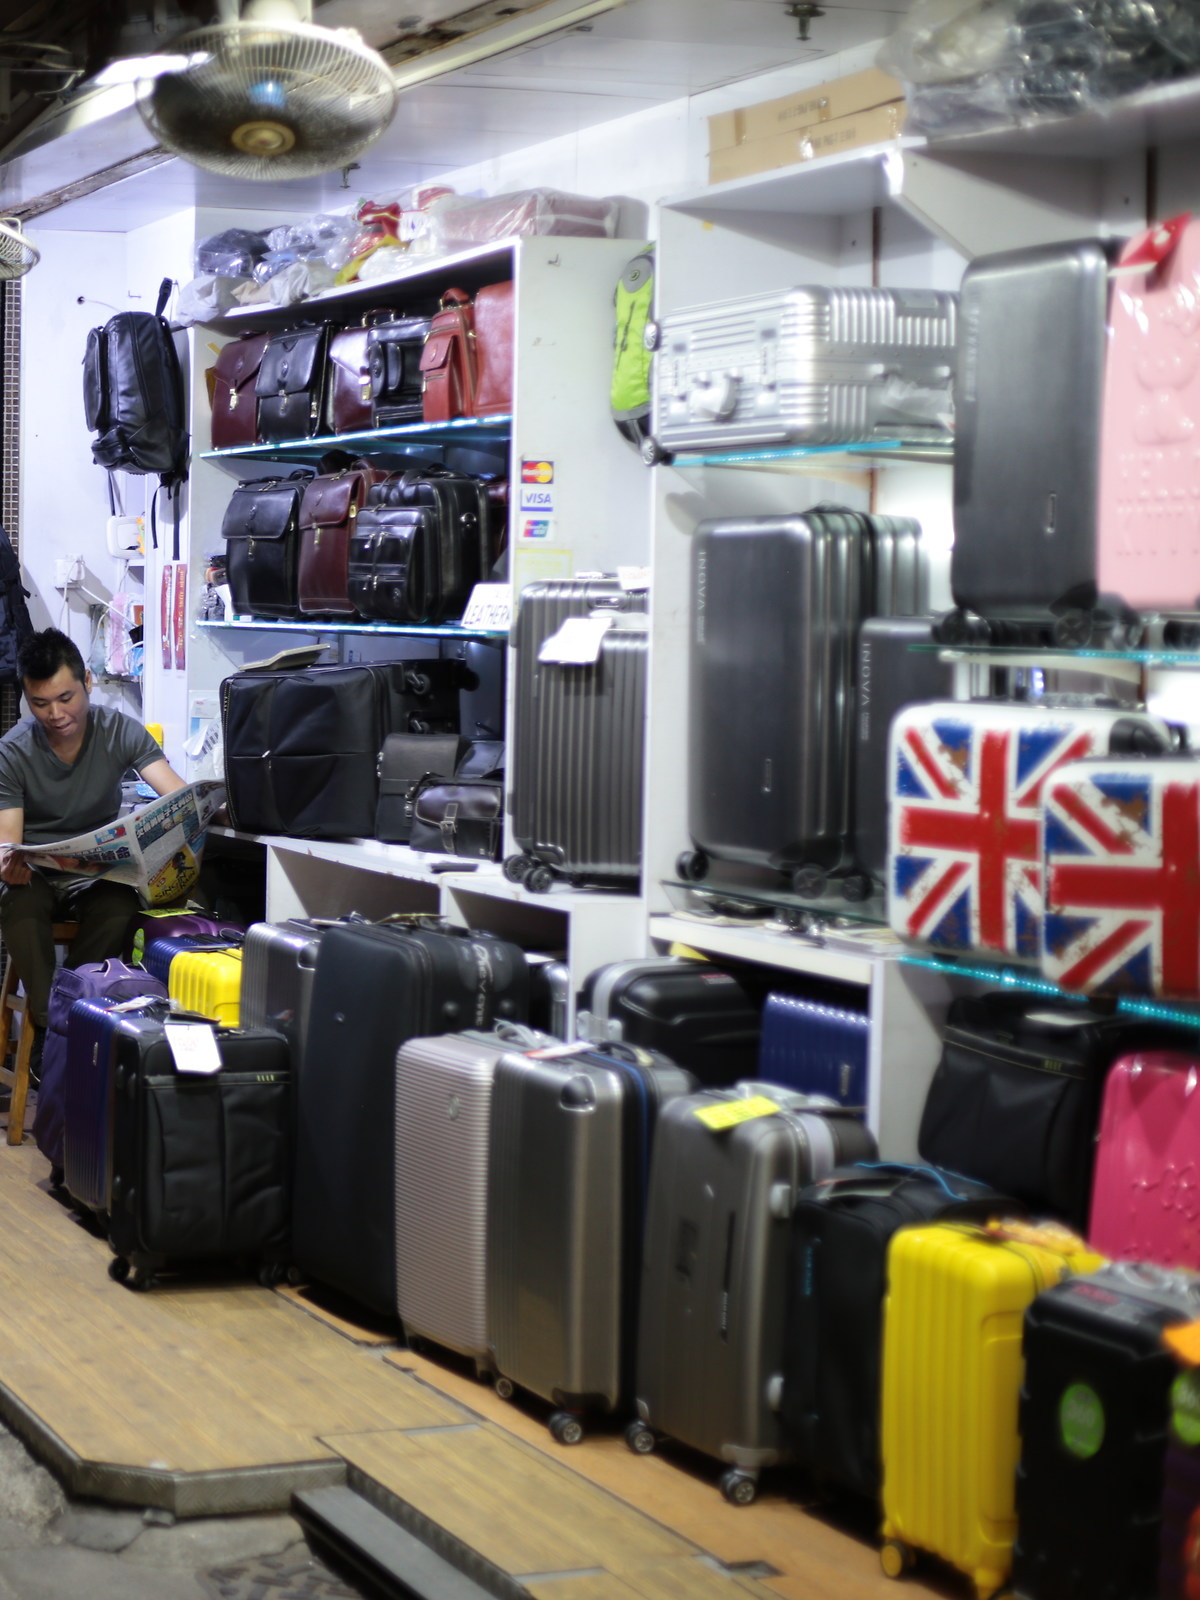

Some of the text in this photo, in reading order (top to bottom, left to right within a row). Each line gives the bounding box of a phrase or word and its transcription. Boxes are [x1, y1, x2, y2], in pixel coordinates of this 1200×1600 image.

[525, 493, 552, 504] VISA
[698, 551, 707, 611] INOVA
[862, 643, 872, 706] INOVA
